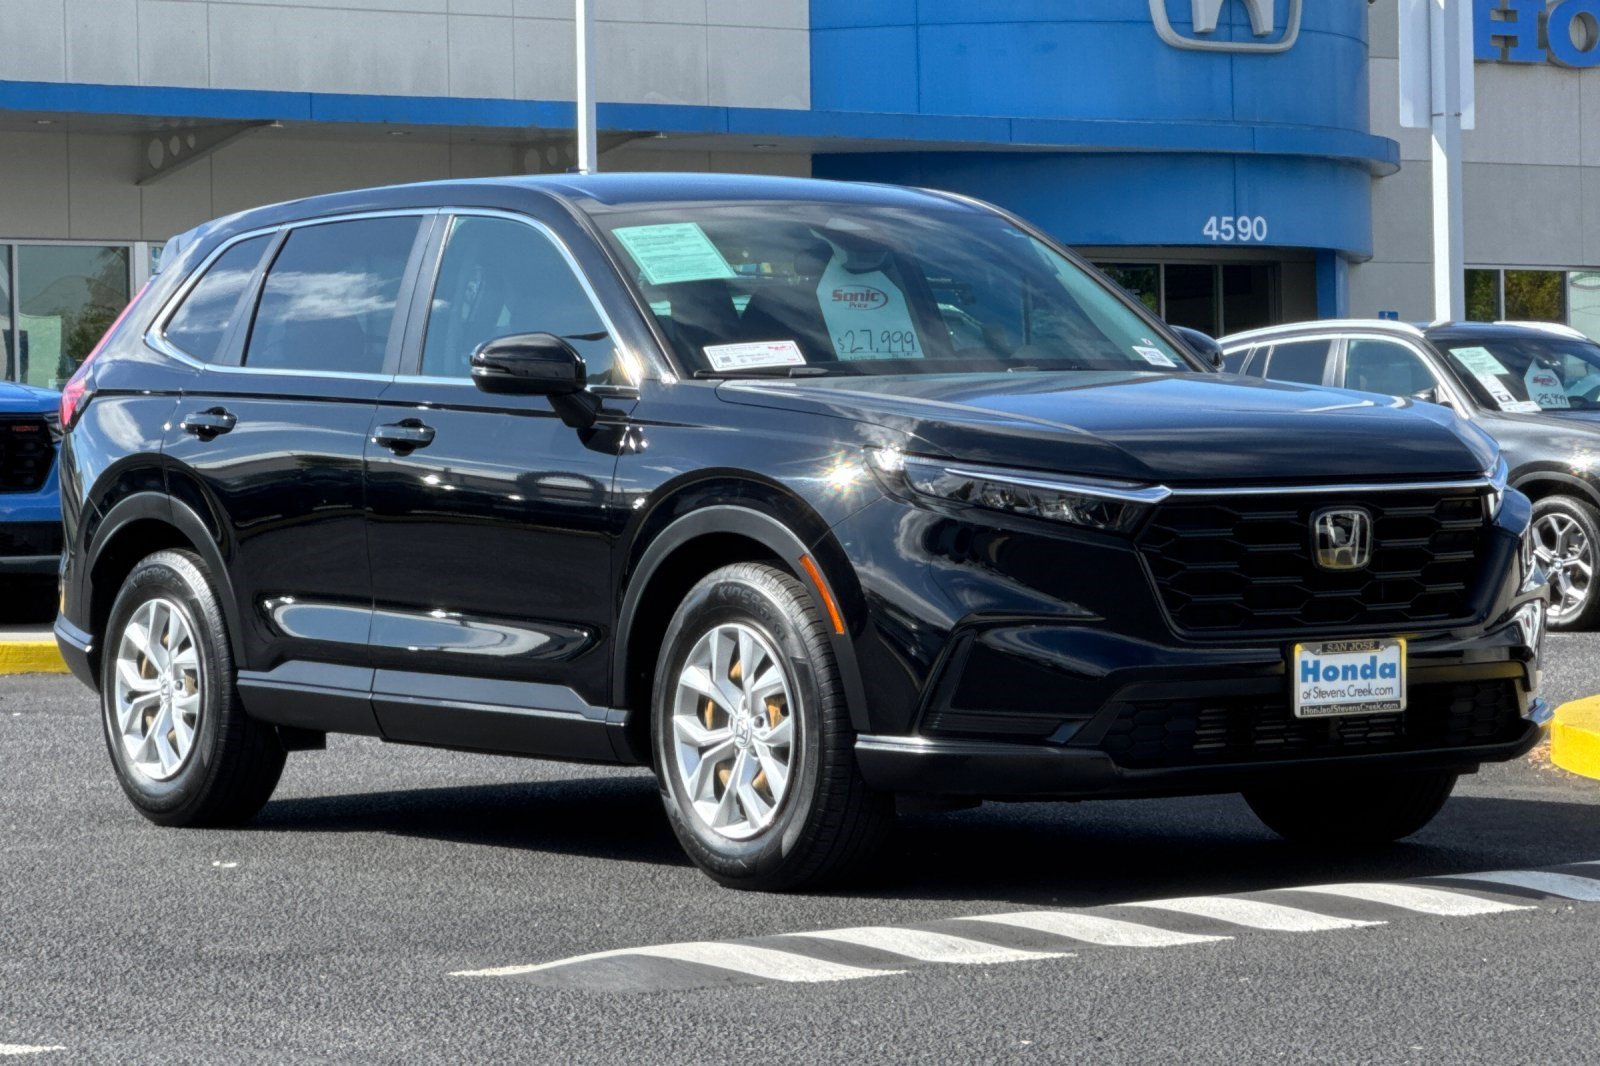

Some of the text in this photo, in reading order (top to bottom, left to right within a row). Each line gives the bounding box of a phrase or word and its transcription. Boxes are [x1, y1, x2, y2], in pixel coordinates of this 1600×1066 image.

[1203, 215, 1267, 241] 4590
[832, 288, 880, 302] Sonic
[1327, 641, 1376, 652] SAN JOSE
[1301, 656, 1396, 683] Honda
[1303, 683, 1393, 700] of Stevens Creek.com
